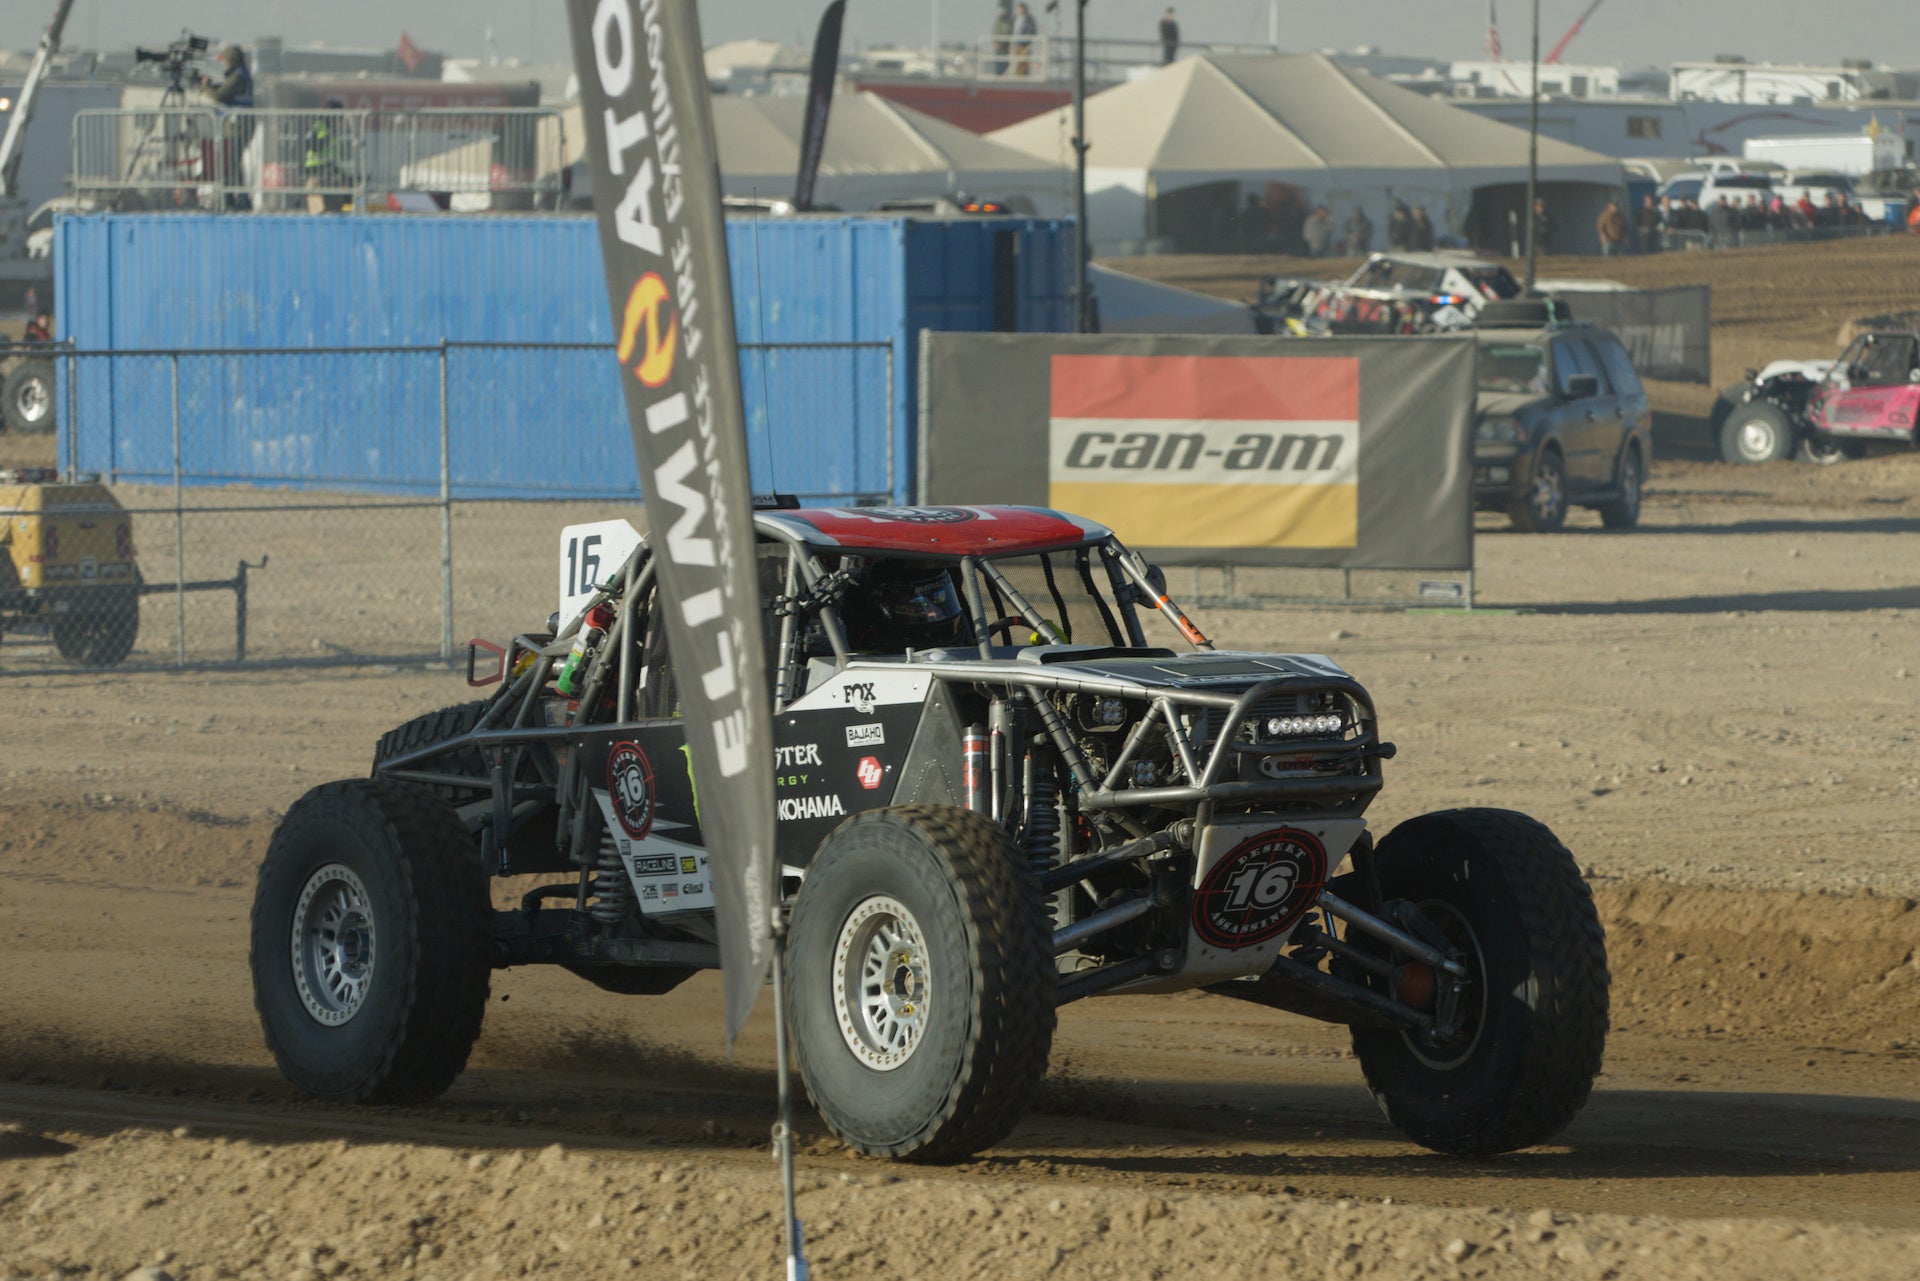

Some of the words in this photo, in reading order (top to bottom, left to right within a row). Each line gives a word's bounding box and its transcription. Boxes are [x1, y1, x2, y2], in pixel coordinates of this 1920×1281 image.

[671, 226, 702, 359] FIRE
[1065, 431, 1344, 471] can-am
[568, 535, 601, 597] 16
[843, 683, 876, 704] FOX
[619, 768, 644, 808] 16
[636, 859, 675, 872] RACELINE
[1238, 843, 1306, 866] DESERT
[1225, 860, 1300, 911] 16
